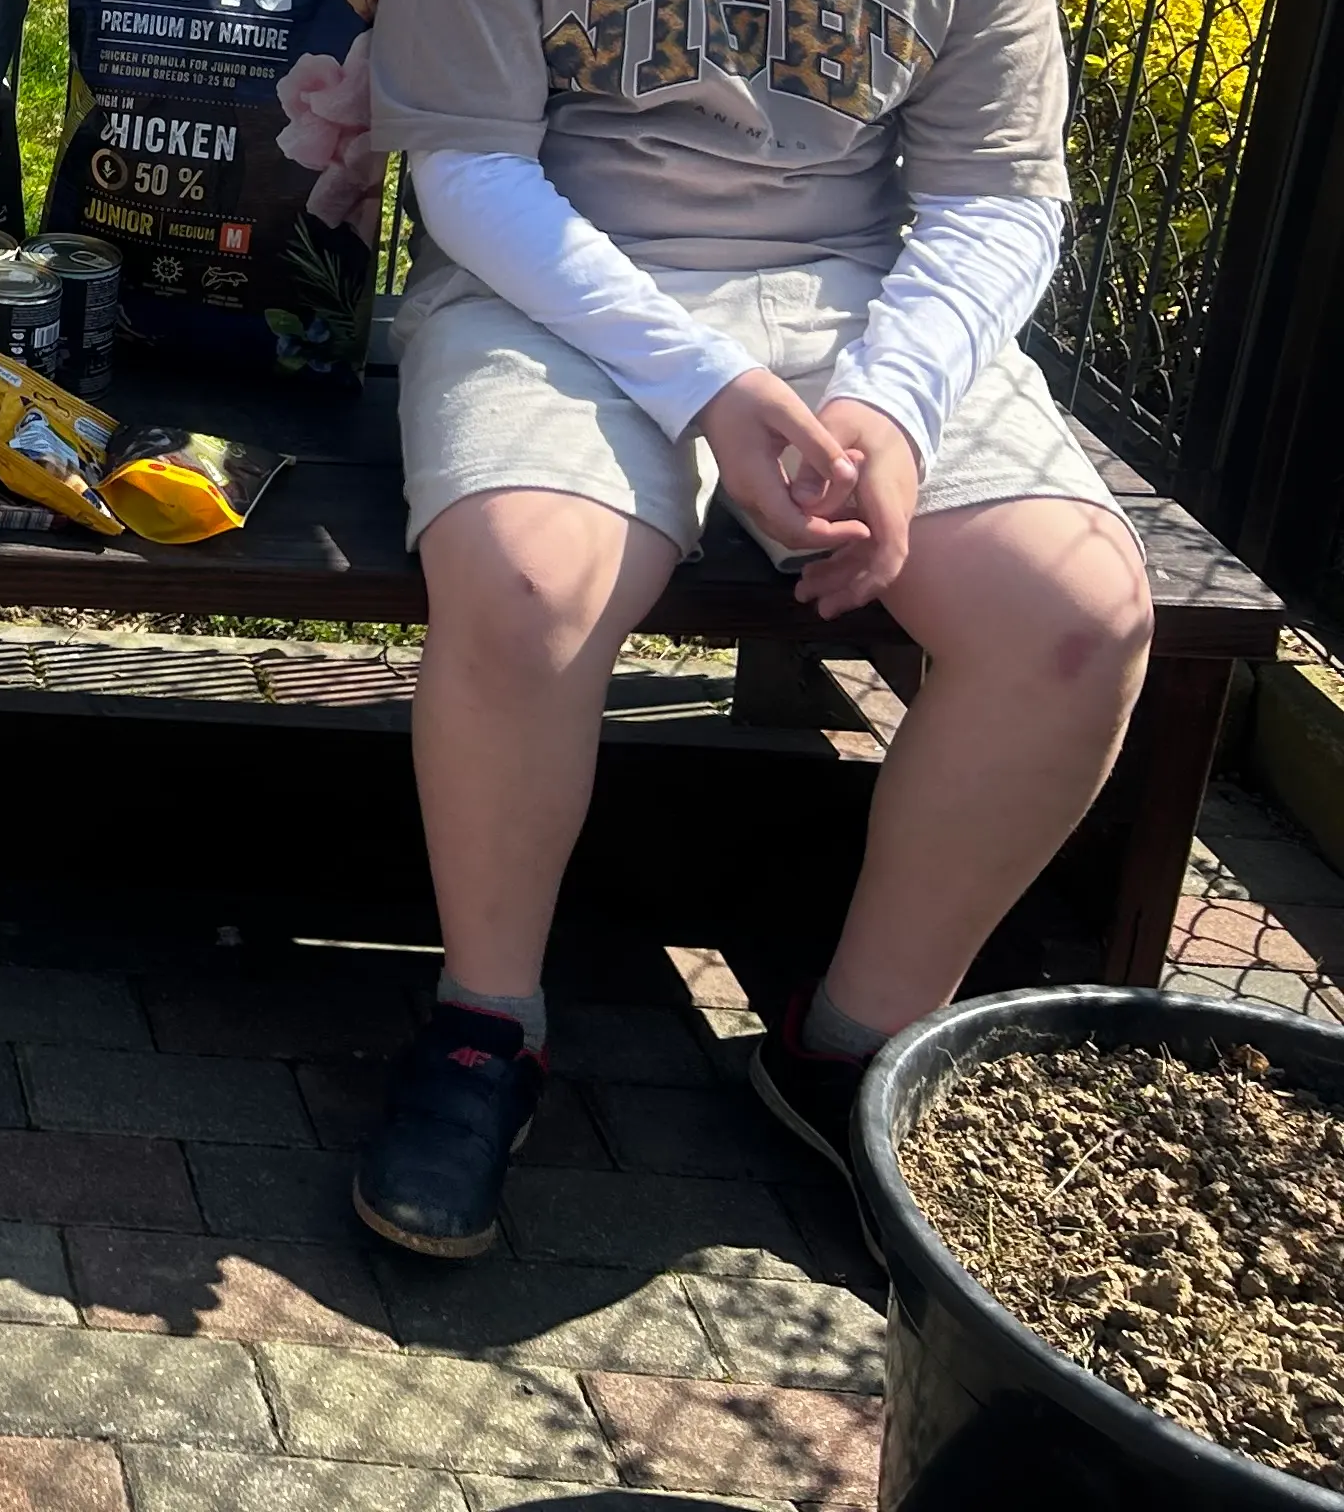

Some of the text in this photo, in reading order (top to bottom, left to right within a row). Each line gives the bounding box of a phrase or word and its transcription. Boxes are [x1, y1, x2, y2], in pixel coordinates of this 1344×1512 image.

[100, 9, 290, 51] PREMIUM BY NATURE
[98, 63, 236, 88] OF MEDIUM BREEDS 10-25 KG
[99, 49, 276, 79] CHICKEN FORMULA FOR JUNIOR DOGS
[96, 93, 135, 110] HIGH IN
[134, 162, 205, 201] 50 %
[84, 197, 243, 249] JUNIOR MEDIUM M
